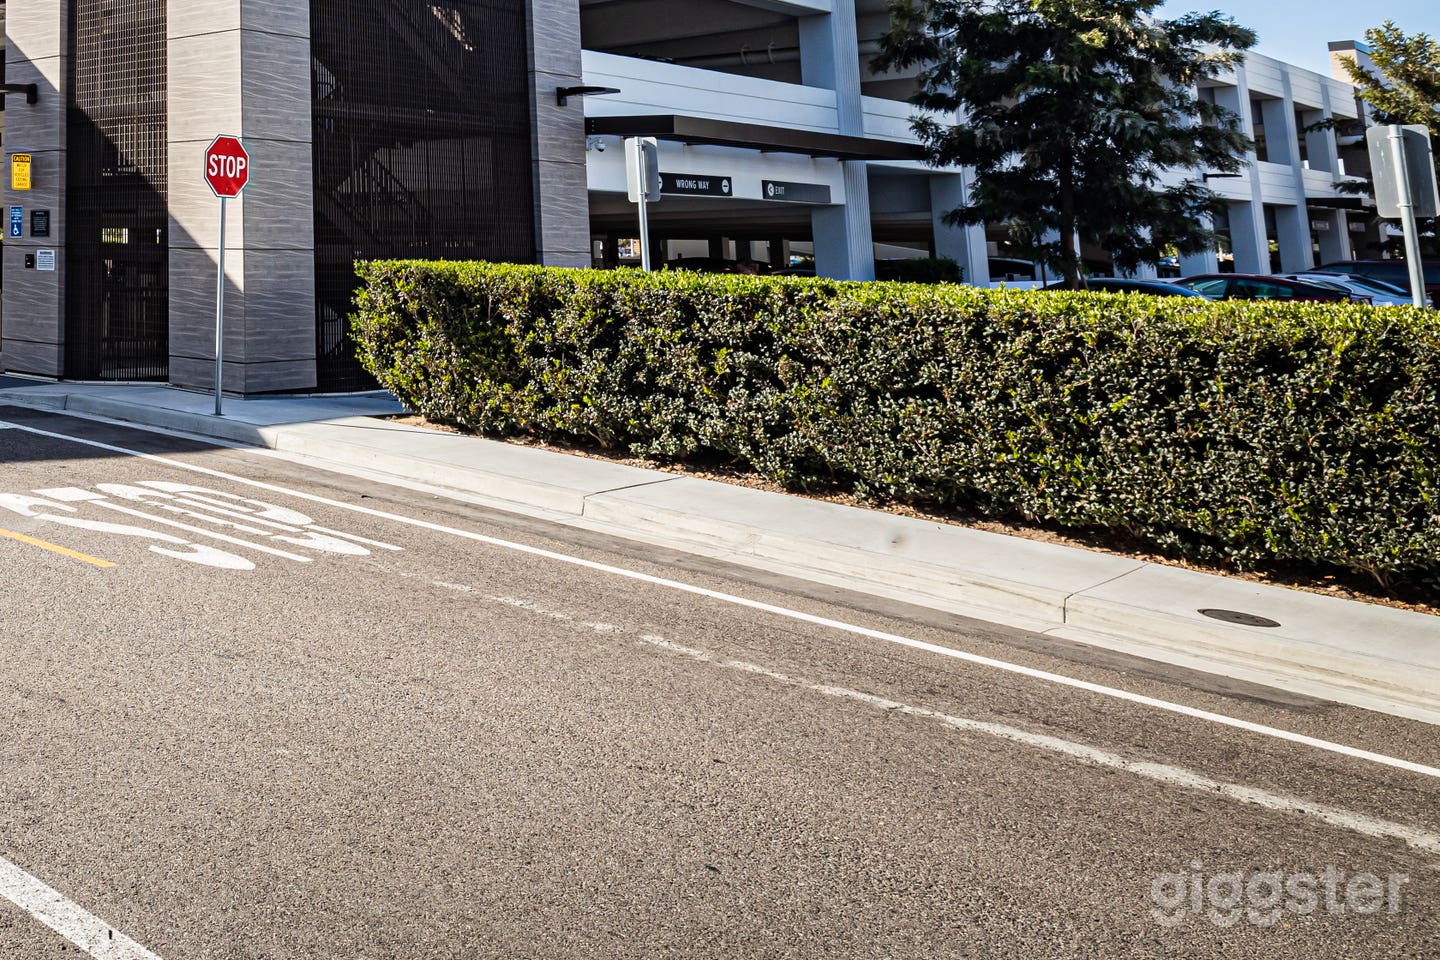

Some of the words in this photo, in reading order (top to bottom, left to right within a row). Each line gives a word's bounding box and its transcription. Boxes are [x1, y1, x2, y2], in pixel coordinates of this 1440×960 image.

[208, 154, 246, 178] STOP
[675, 179, 697, 189] WRONG
[697, 180, 709, 190] WAY
[775, 186, 785, 195] EXIT
